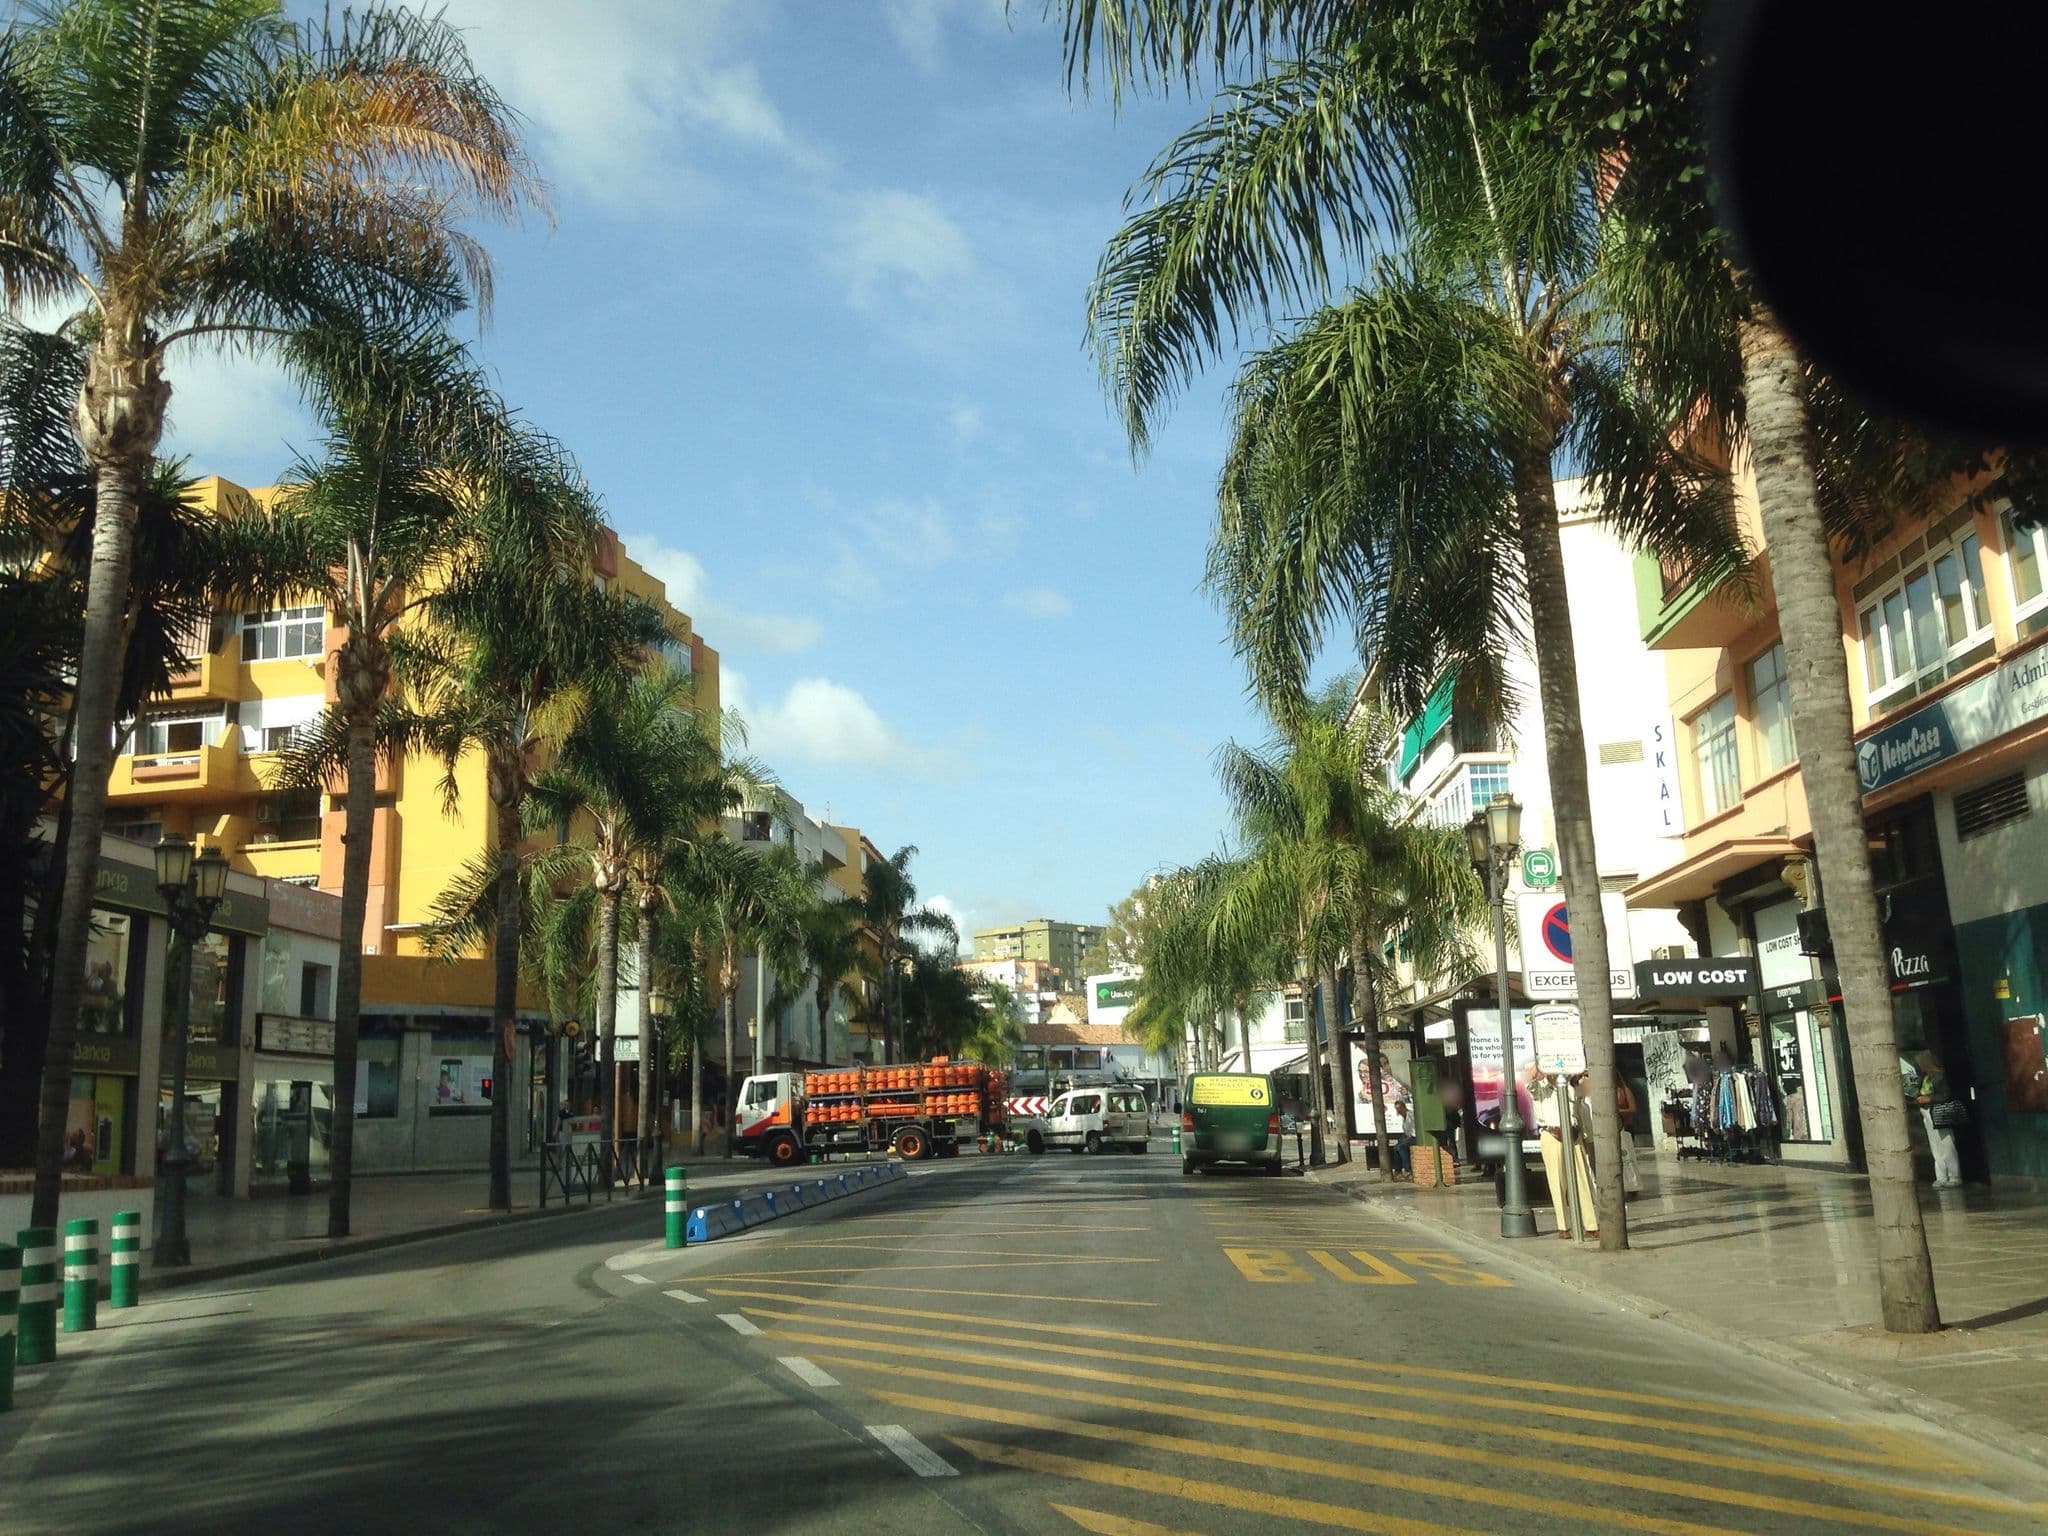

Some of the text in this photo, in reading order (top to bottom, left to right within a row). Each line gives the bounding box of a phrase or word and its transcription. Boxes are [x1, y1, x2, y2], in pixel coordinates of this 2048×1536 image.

[2011, 656, 2048, 693] Admi
[1533, 877, 1550, 885] BUS
[1778, 936, 1793, 950] COST
[1534, 975, 1577, 986] EXCEP
[1652, 969, 1748, 986] LOW COST
[1480, 1051, 1491, 1059] for
[1222, 1247, 1515, 1288] BUS
